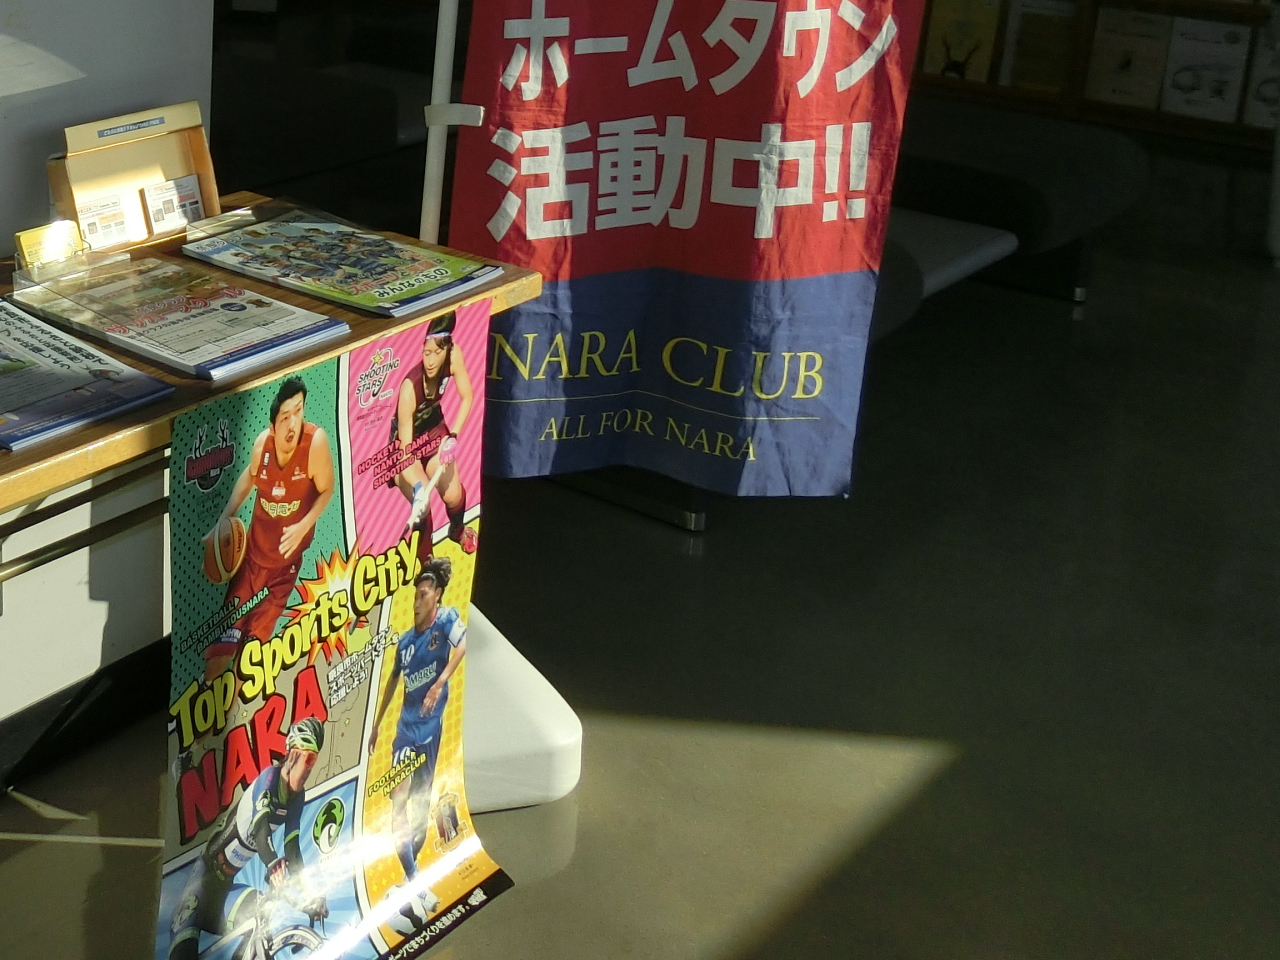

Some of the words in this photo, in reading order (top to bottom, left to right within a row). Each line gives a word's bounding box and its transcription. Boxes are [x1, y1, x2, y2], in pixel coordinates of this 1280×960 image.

[486, 115, 872, 242] 活動中!!
[373, 267, 450, 299] みんなのもの
[355, 377, 383, 396] STARS
[359, 359, 400, 384] SHOOTING
[486, 328, 640, 381] NARA
[661, 336, 825, 400] CLUB
[373, 449, 404, 478] NANTO
[404, 432, 430, 454] BANK
[540, 414, 591, 443] ALL
[598, 407, 655, 436] FOR
[663, 416, 756, 461] NARA
[357, 443, 396, 476] HOCKEY
[372, 455, 416, 490] SHOOTING
[415, 436, 442, 460] STARS
[170, 670, 235, 748] Top
[239, 591, 349, 702] Sports
[352, 530, 422, 611] City
[180, 603, 238, 654] BASKETBALL
[197, 587, 270, 654] BAMBITIOUSNARA
[327, 626, 393, 682] 奈良市ホームタウン
[399, 644, 415, 667] 10
[328, 669, 370, 709] 応援しよう!
[180, 665, 329, 840] NARA
[368, 755, 411, 797] FOOTBALL
[383, 752, 427, 797] NARACLUB
